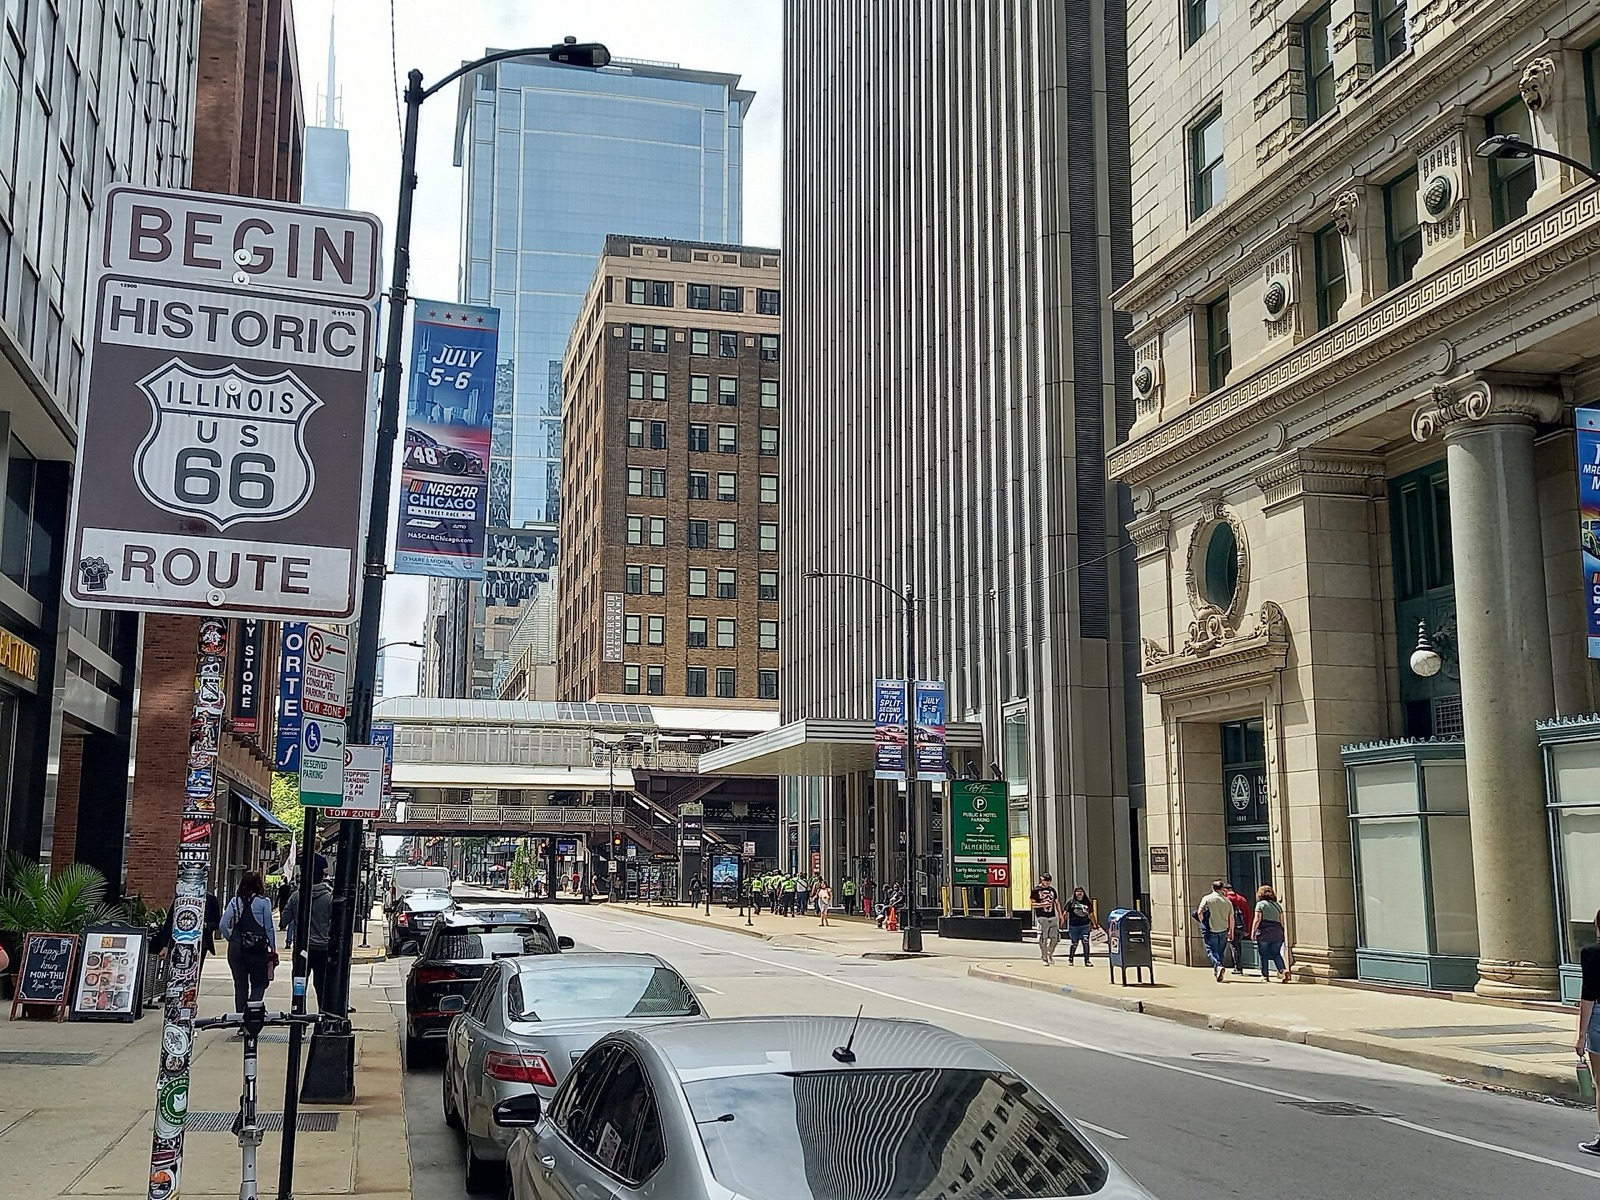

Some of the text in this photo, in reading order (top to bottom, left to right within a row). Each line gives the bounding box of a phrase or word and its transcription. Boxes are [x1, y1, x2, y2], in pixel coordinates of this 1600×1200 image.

[128, 204, 355, 285] BEGIN
[109, 295, 357, 358] HISTORIC
[431, 346, 483, 369] JULY
[427, 368, 472, 390] 5-6
[166, 380, 295, 415] ILLINOIS
[413, 446, 438, 465] 48
[174, 447, 276, 509] 66
[426, 482, 479, 499] NASCAR
[409, 493, 476, 510] CHICAGO
[446, 510, 460, 518] RACE
[407, 532, 474, 544] NASCARChicago.com
[121, 544, 311, 595] ROUTE
[606, 595, 616, 658] MILLER'S PUB
[614, 596, 622, 659] RESTAURANT
[241, 645, 255, 708] STORE
[306, 666, 336, 682] PHILIPPINES
[306, 677, 334, 691] CONSULATE
[305, 686, 340, 702] PARKING ONLY
[922, 697, 940, 705] JULY
[305, 700, 342, 718] TOW ZONE
[880, 699, 904, 707] SPLIT-
[922, 705, 938, 713] 5-6
[879, 712, 902, 722] CITY
[303, 758, 328, 770] RESERVED
[302, 767, 324, 780] PARKING
[329, 809, 376, 818] TOW ZONE
[31, 939, 59, 961] Happy
[29, 971, 65, 980] MON-THU
